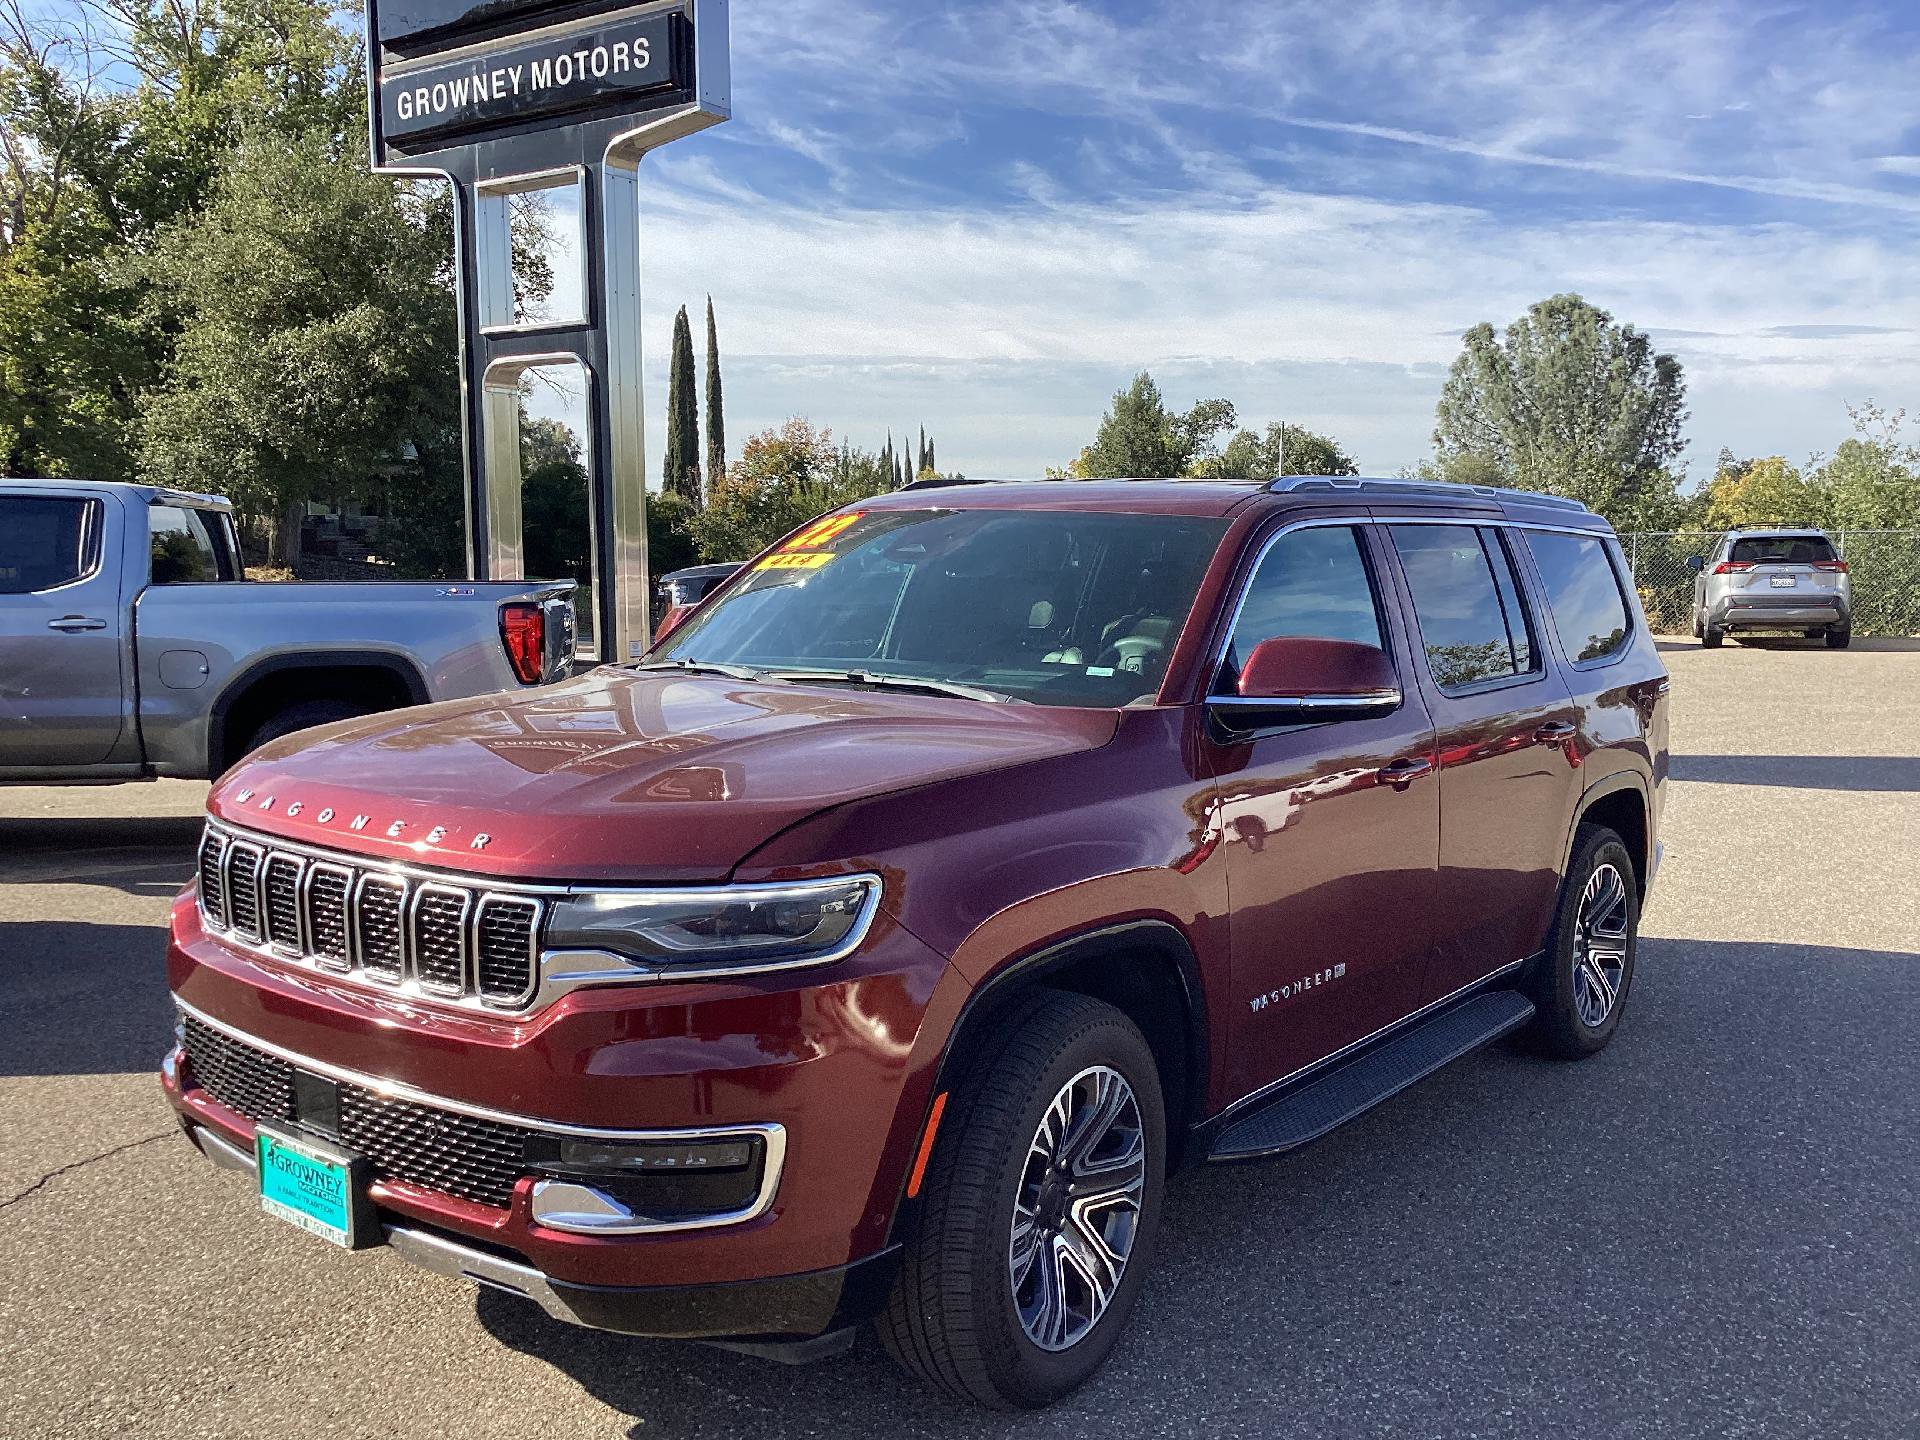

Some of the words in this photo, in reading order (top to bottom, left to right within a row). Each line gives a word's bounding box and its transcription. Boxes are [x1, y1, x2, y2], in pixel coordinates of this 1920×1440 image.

[398, 65, 523, 120] GROWNEY
[531, 37, 651, 92] MOTORS
[235, 788, 492, 849] WAGONEER
[1250, 968, 1332, 1013] WAGONEER
[273, 1154, 343, 1195] GROWNEY
